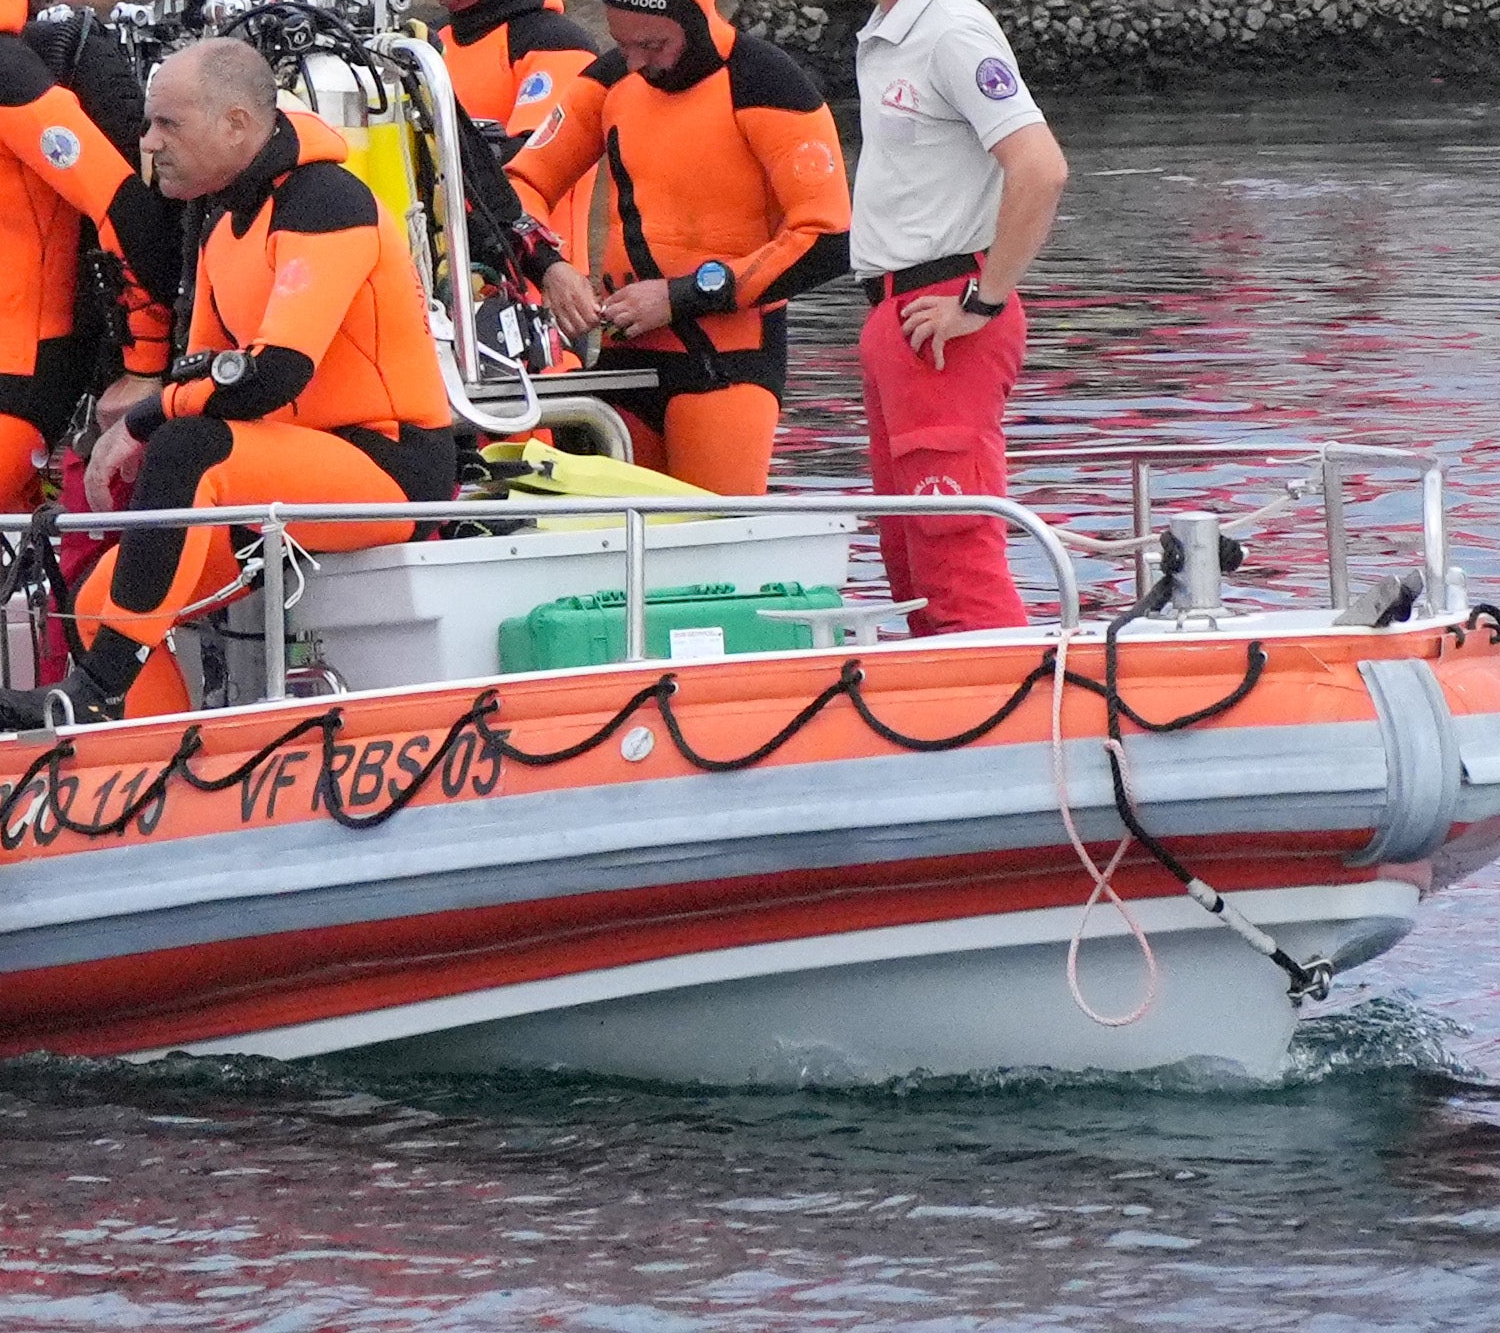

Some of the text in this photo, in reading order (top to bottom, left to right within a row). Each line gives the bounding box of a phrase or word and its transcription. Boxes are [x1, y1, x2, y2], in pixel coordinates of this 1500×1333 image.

[239, 750, 311, 824] VF
[311, 733, 431, 812] RBS
[440, 728, 513, 799] 05
